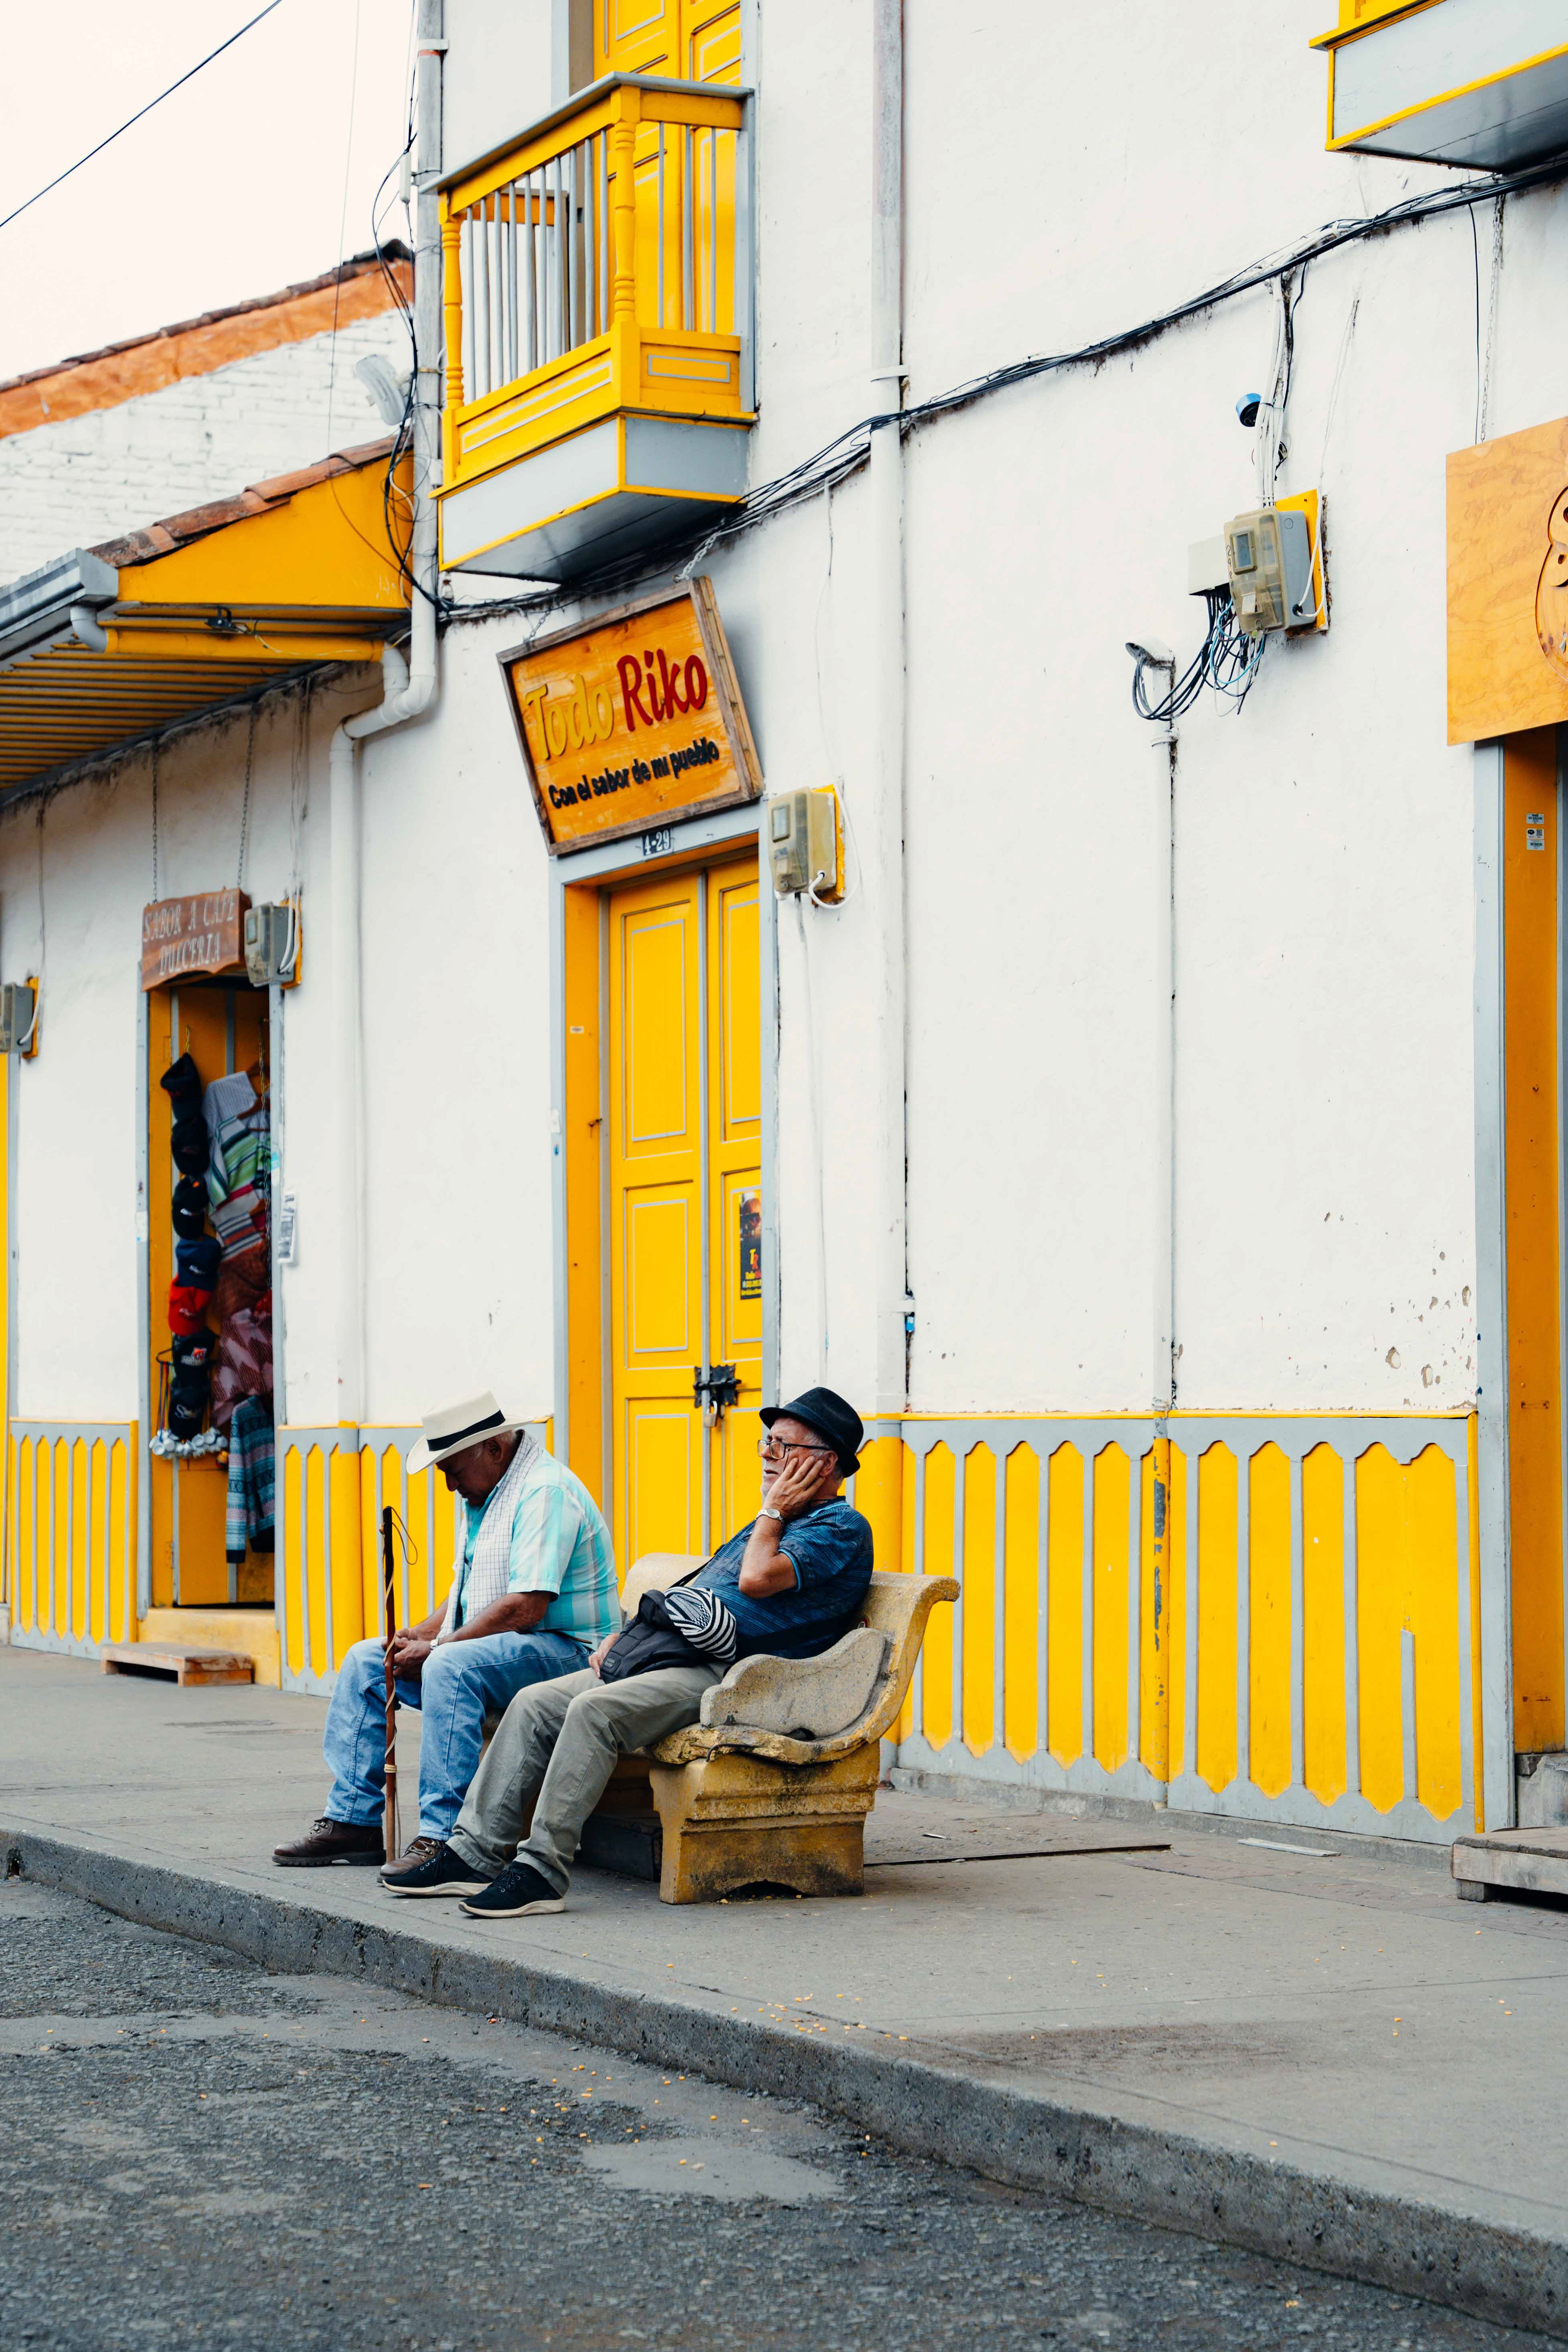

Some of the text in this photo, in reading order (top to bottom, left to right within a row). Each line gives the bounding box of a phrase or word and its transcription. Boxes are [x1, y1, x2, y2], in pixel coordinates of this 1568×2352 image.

[525, 648, 708, 761] Todo Riko
[548, 736, 719, 808] Con el sabor de mi pueblo
[143, 904, 182, 942] SABOR
[188, 900, 197, 931] A
